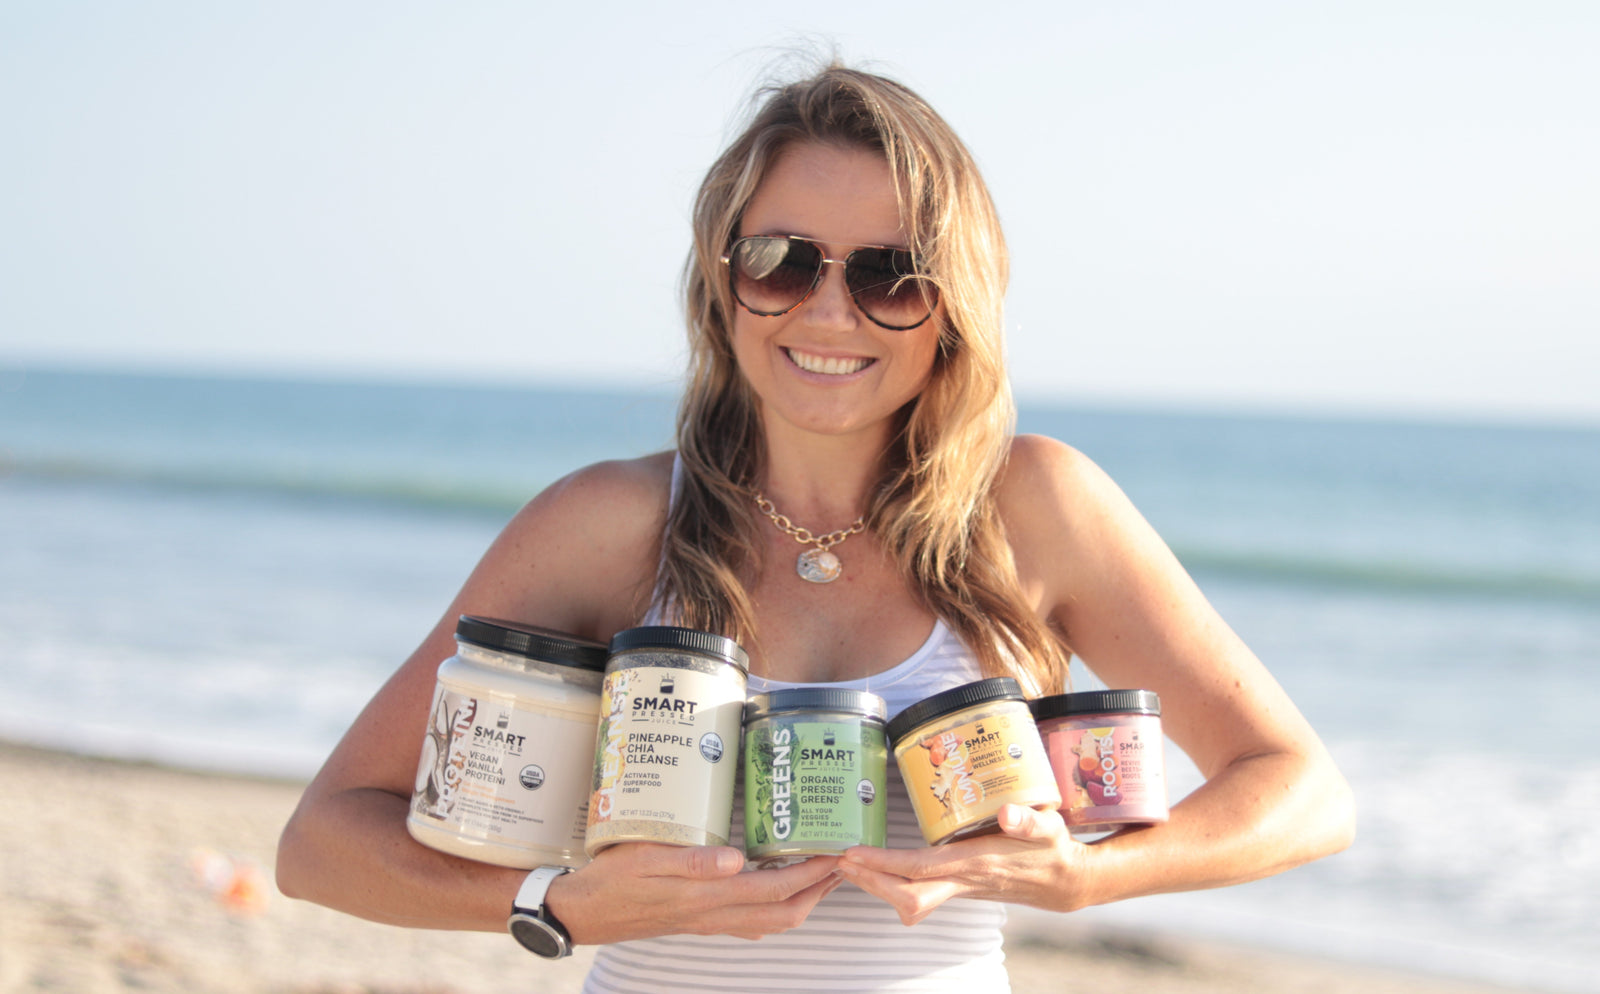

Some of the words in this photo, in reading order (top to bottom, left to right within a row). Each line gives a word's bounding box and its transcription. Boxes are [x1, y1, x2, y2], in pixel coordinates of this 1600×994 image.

[632, 697, 698, 714] SMART
[632, 711, 695, 721] PRESSED
[475, 726, 526, 746] SMART
[629, 733, 693, 747] PINEAPPLE
[965, 731, 1000, 748] SMART
[599, 674, 629, 817] CLEANSE
[627, 744, 655, 753] CHIA
[1120, 743, 1144, 751] SMAR
[470, 751, 498, 764] VEGAN
[626, 754, 679, 766] CLEANSE
[801, 749, 855, 761] SMART
[973, 755, 1006, 769] WELLNESS
[468, 760, 503, 775] VANILLA
[941, 732, 977, 805] IMMUNE
[1101, 736, 1117, 797] ROOTS
[773, 728, 791, 839] GREENS
[801, 775, 845, 784] ORGANIC
[801, 785, 844, 794] PRESSED
[801, 795, 840, 804] GREENS
